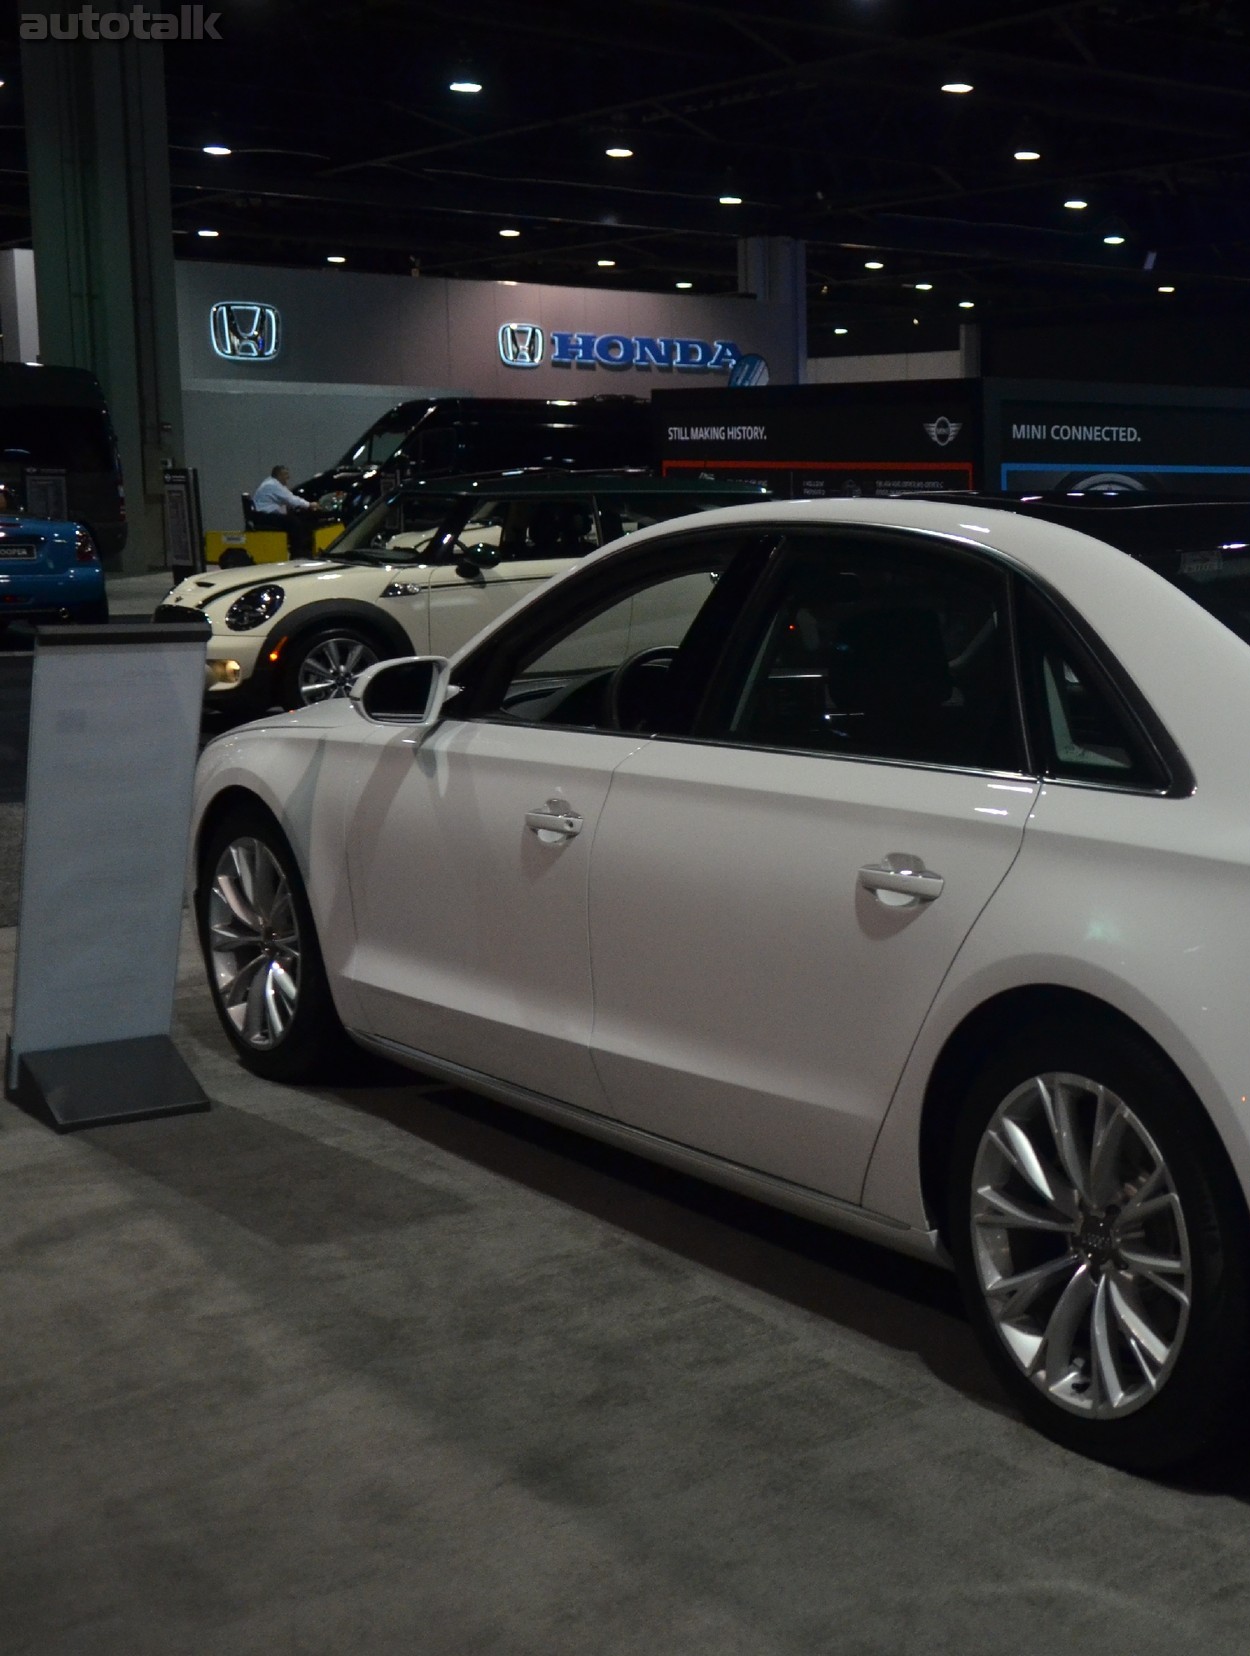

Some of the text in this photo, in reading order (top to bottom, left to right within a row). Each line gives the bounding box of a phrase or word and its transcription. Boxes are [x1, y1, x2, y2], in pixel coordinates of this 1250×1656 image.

[550, 332, 743, 369] HONDA
[668, 425, 767, 441] STILL MAKING HISTORY.
[1012, 424, 1142, 442] MINI CONNECTED.
